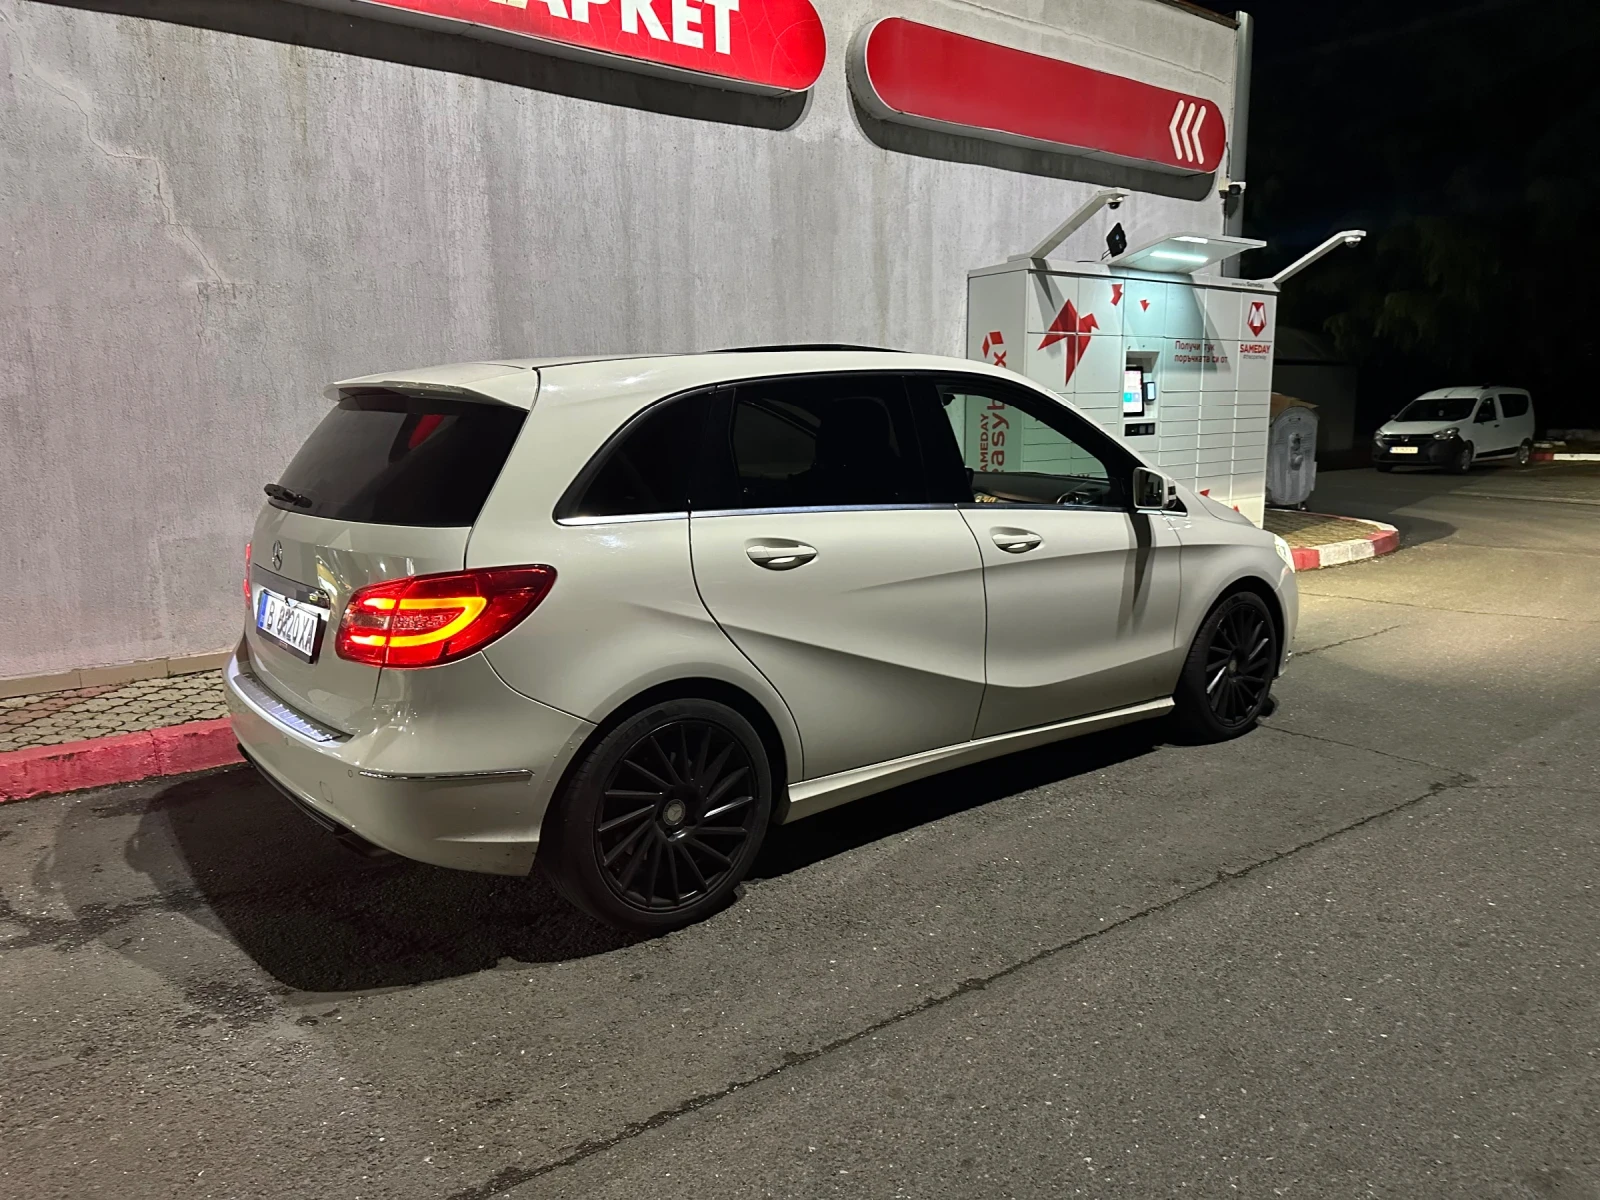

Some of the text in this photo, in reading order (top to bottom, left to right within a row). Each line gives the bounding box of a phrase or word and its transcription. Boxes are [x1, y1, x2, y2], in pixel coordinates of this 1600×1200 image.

[490, 0, 740, 55] КЕТ
[1175, 340, 1215, 352] Получи тук
[1239, 343, 1271, 354] SAMEDAY
[1174, 354, 1210, 364] поръчката
[980, 413, 989, 472] AMEDAY
